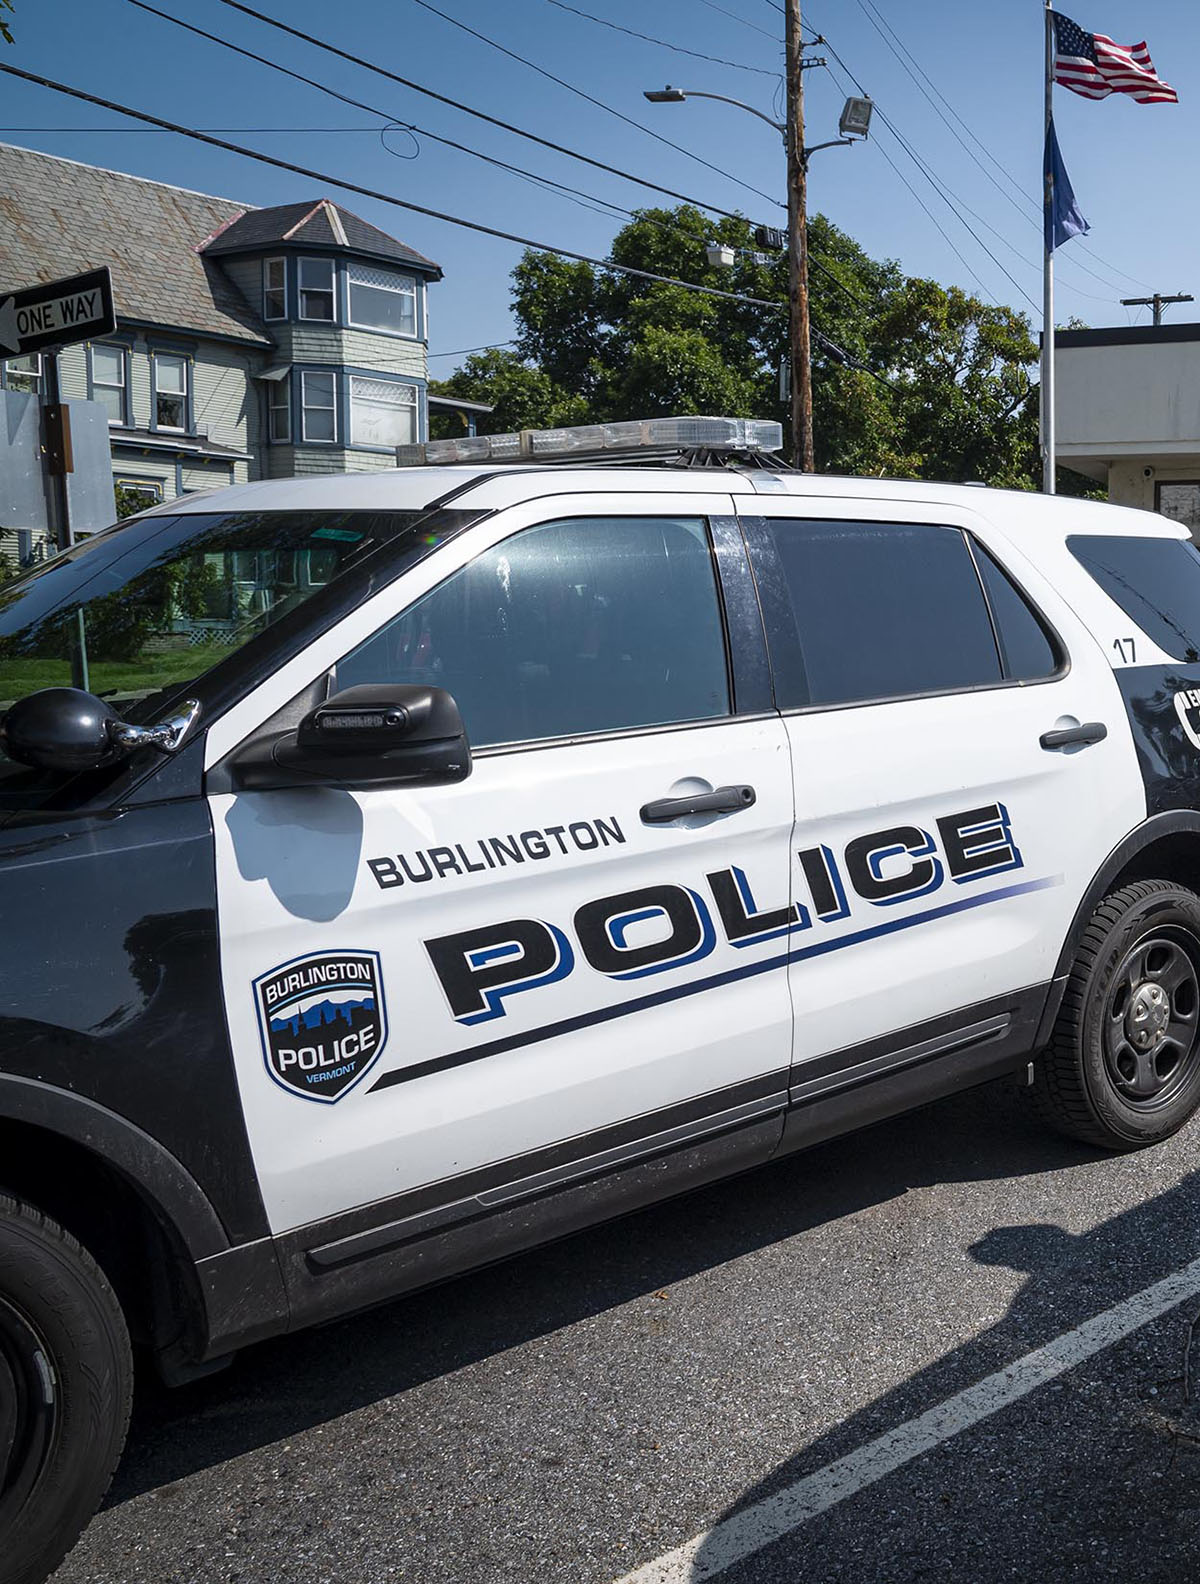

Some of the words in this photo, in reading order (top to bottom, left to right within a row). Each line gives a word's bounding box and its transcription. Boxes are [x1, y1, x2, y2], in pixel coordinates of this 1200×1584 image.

[16, 304, 55, 335] ONE
[60, 292, 97, 324] WAY
[1113, 637, 1136, 663] 17
[366, 815, 627, 890] BURLINGTON
[423, 801, 1024, 1026] POLICE
[265, 962, 372, 1004] BURLINGTON
[278, 1023, 376, 1072] POLICE
[306, 1061, 356, 1084] VERMONT
